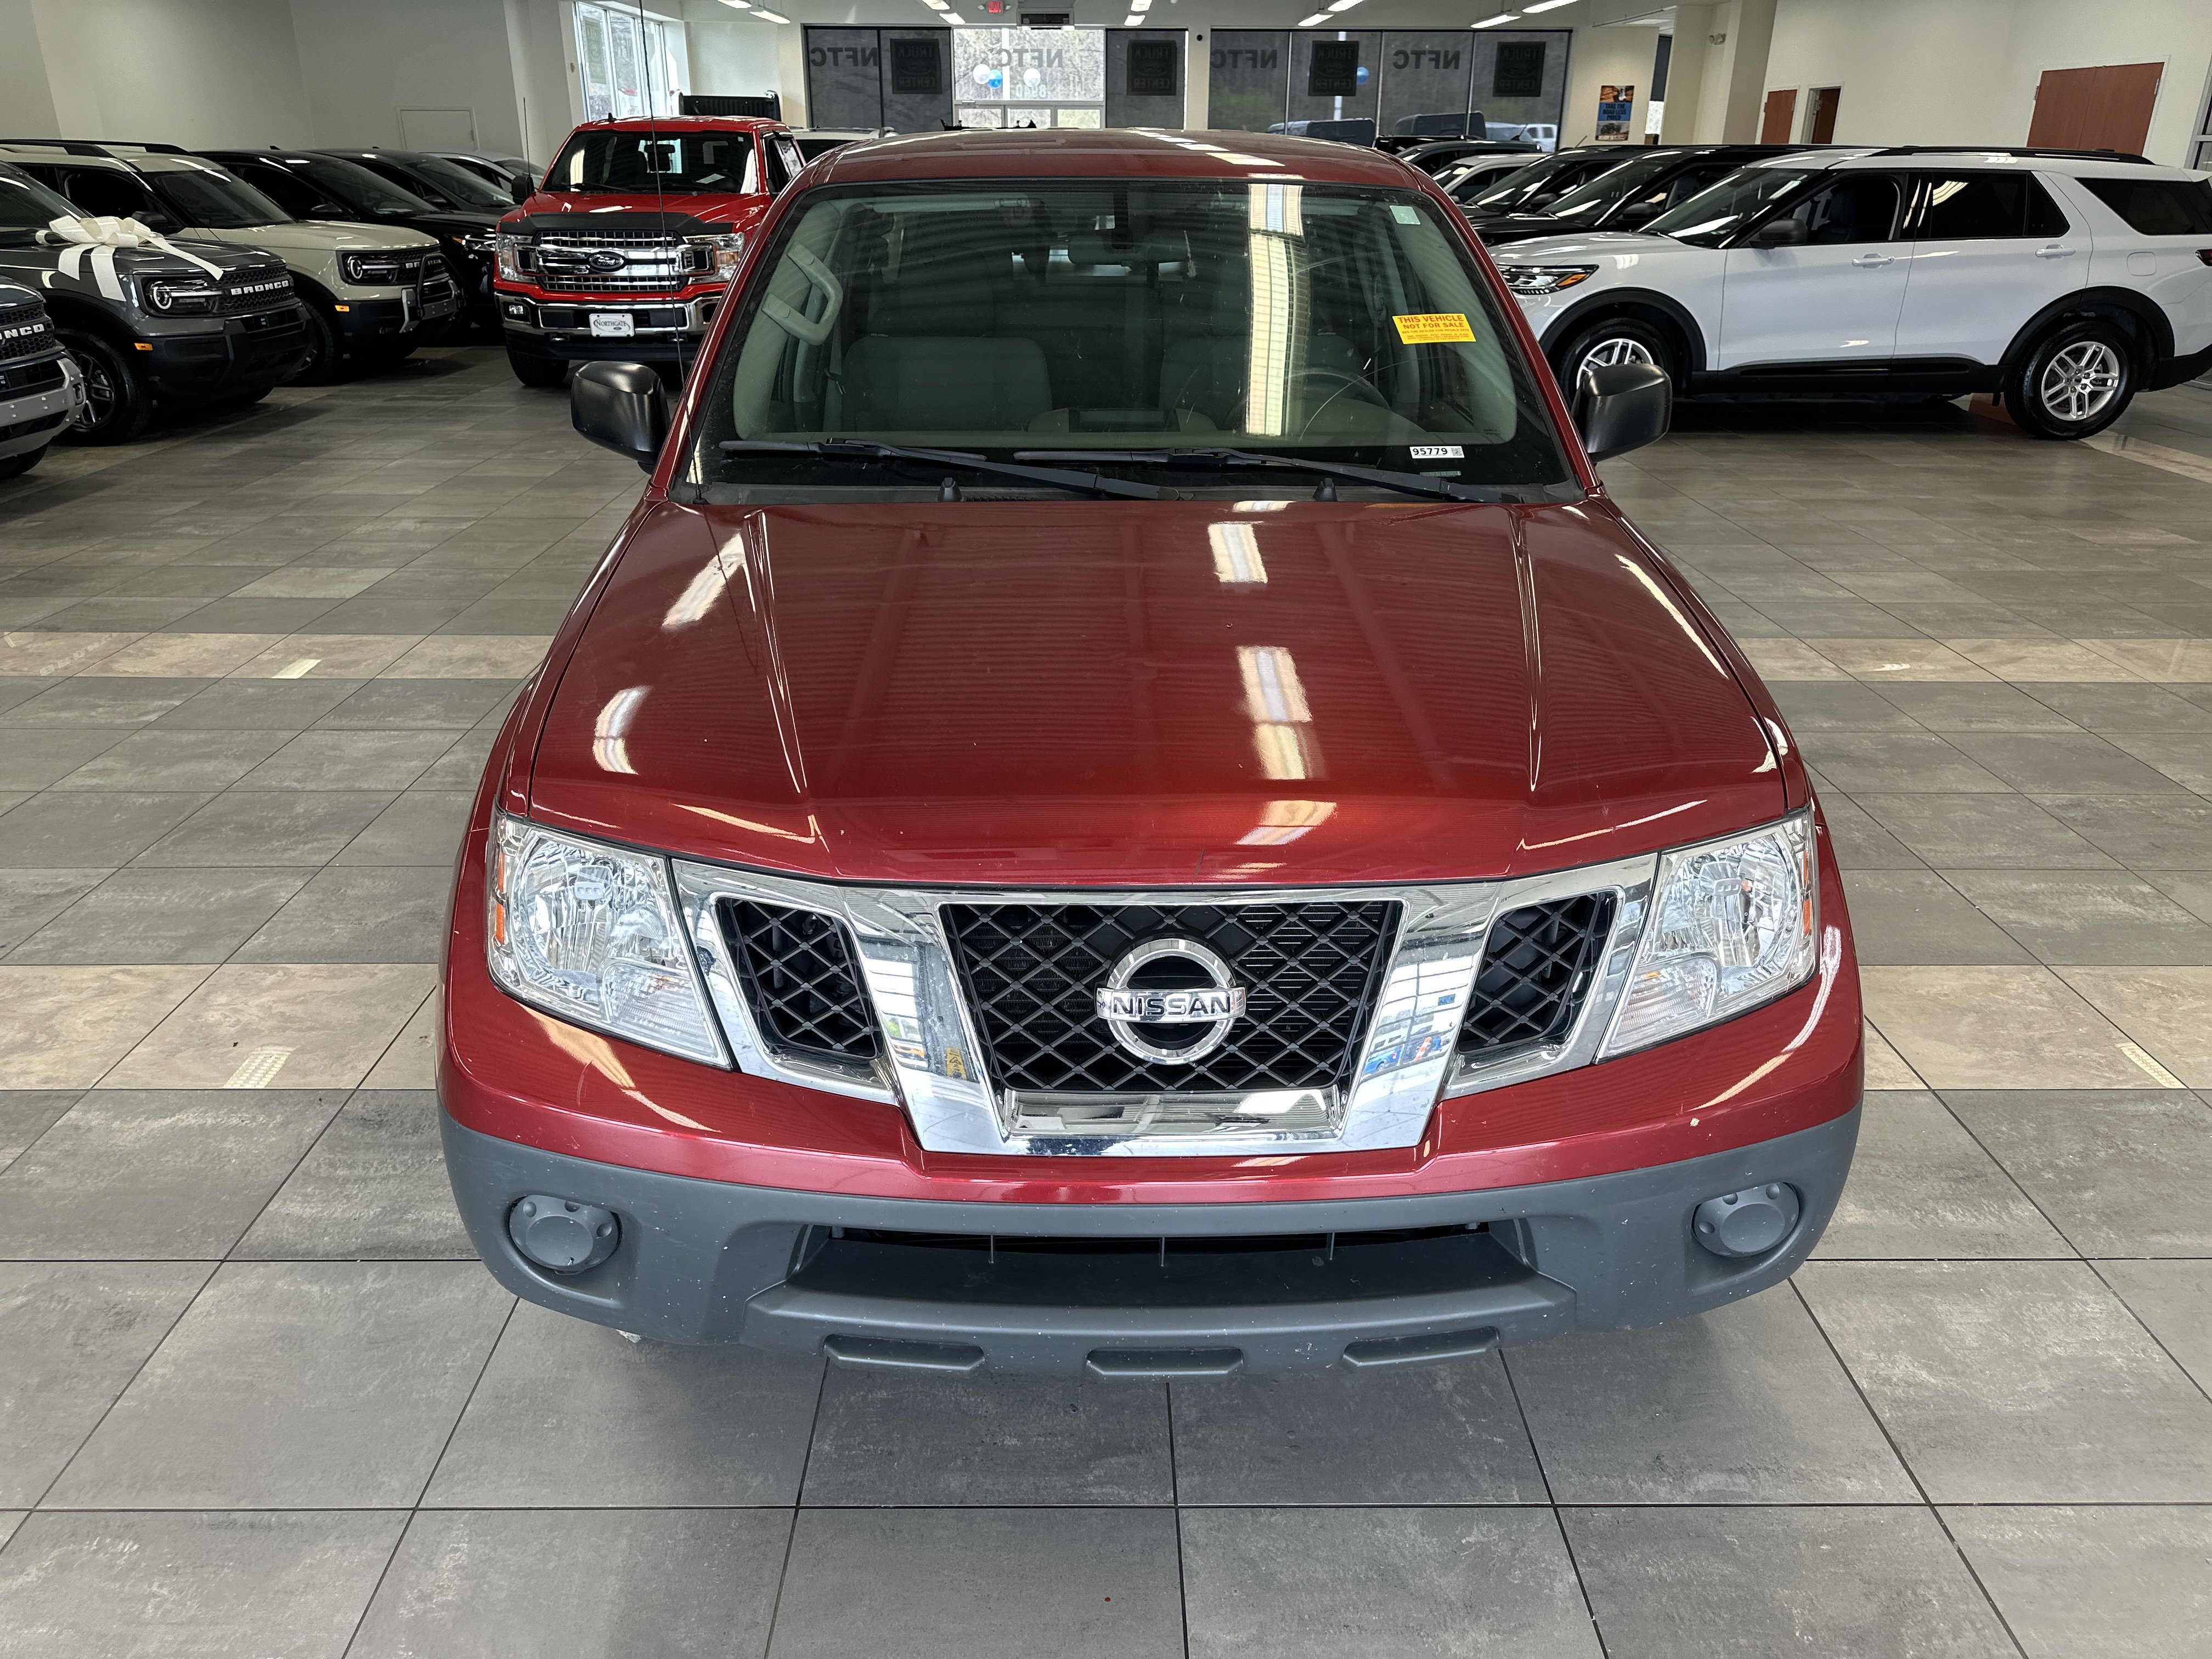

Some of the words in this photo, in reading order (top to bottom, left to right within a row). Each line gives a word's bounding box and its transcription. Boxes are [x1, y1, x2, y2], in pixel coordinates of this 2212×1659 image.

[230, 280, 289, 295] BRONCO
[0, 323, 44, 340] NCO
[1113, 996, 1231, 1017] NISSAN
